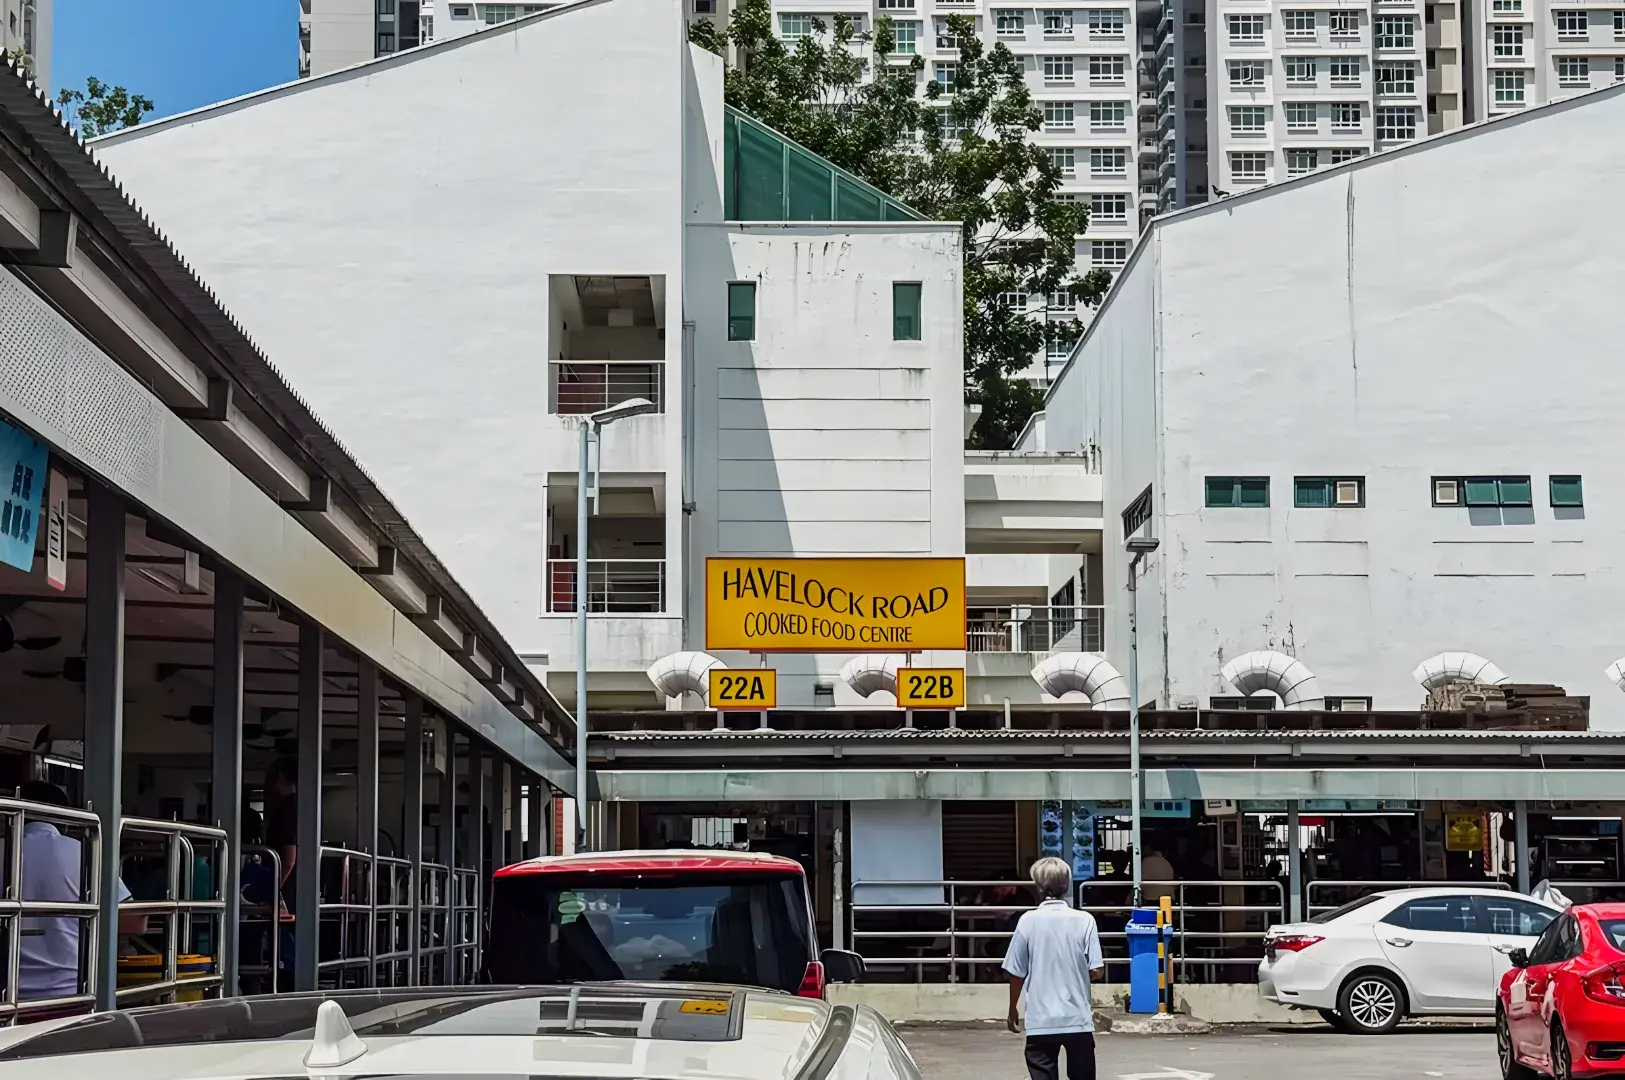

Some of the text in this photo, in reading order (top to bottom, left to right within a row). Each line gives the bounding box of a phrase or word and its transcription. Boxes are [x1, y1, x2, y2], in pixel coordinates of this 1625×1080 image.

[723, 566, 949, 619] HAVELOCK ROAD
[744, 611, 914, 643] COOKED FOOD CENTRE
[719, 675, 765, 700] 22A
[908, 675, 954, 699] 22B
